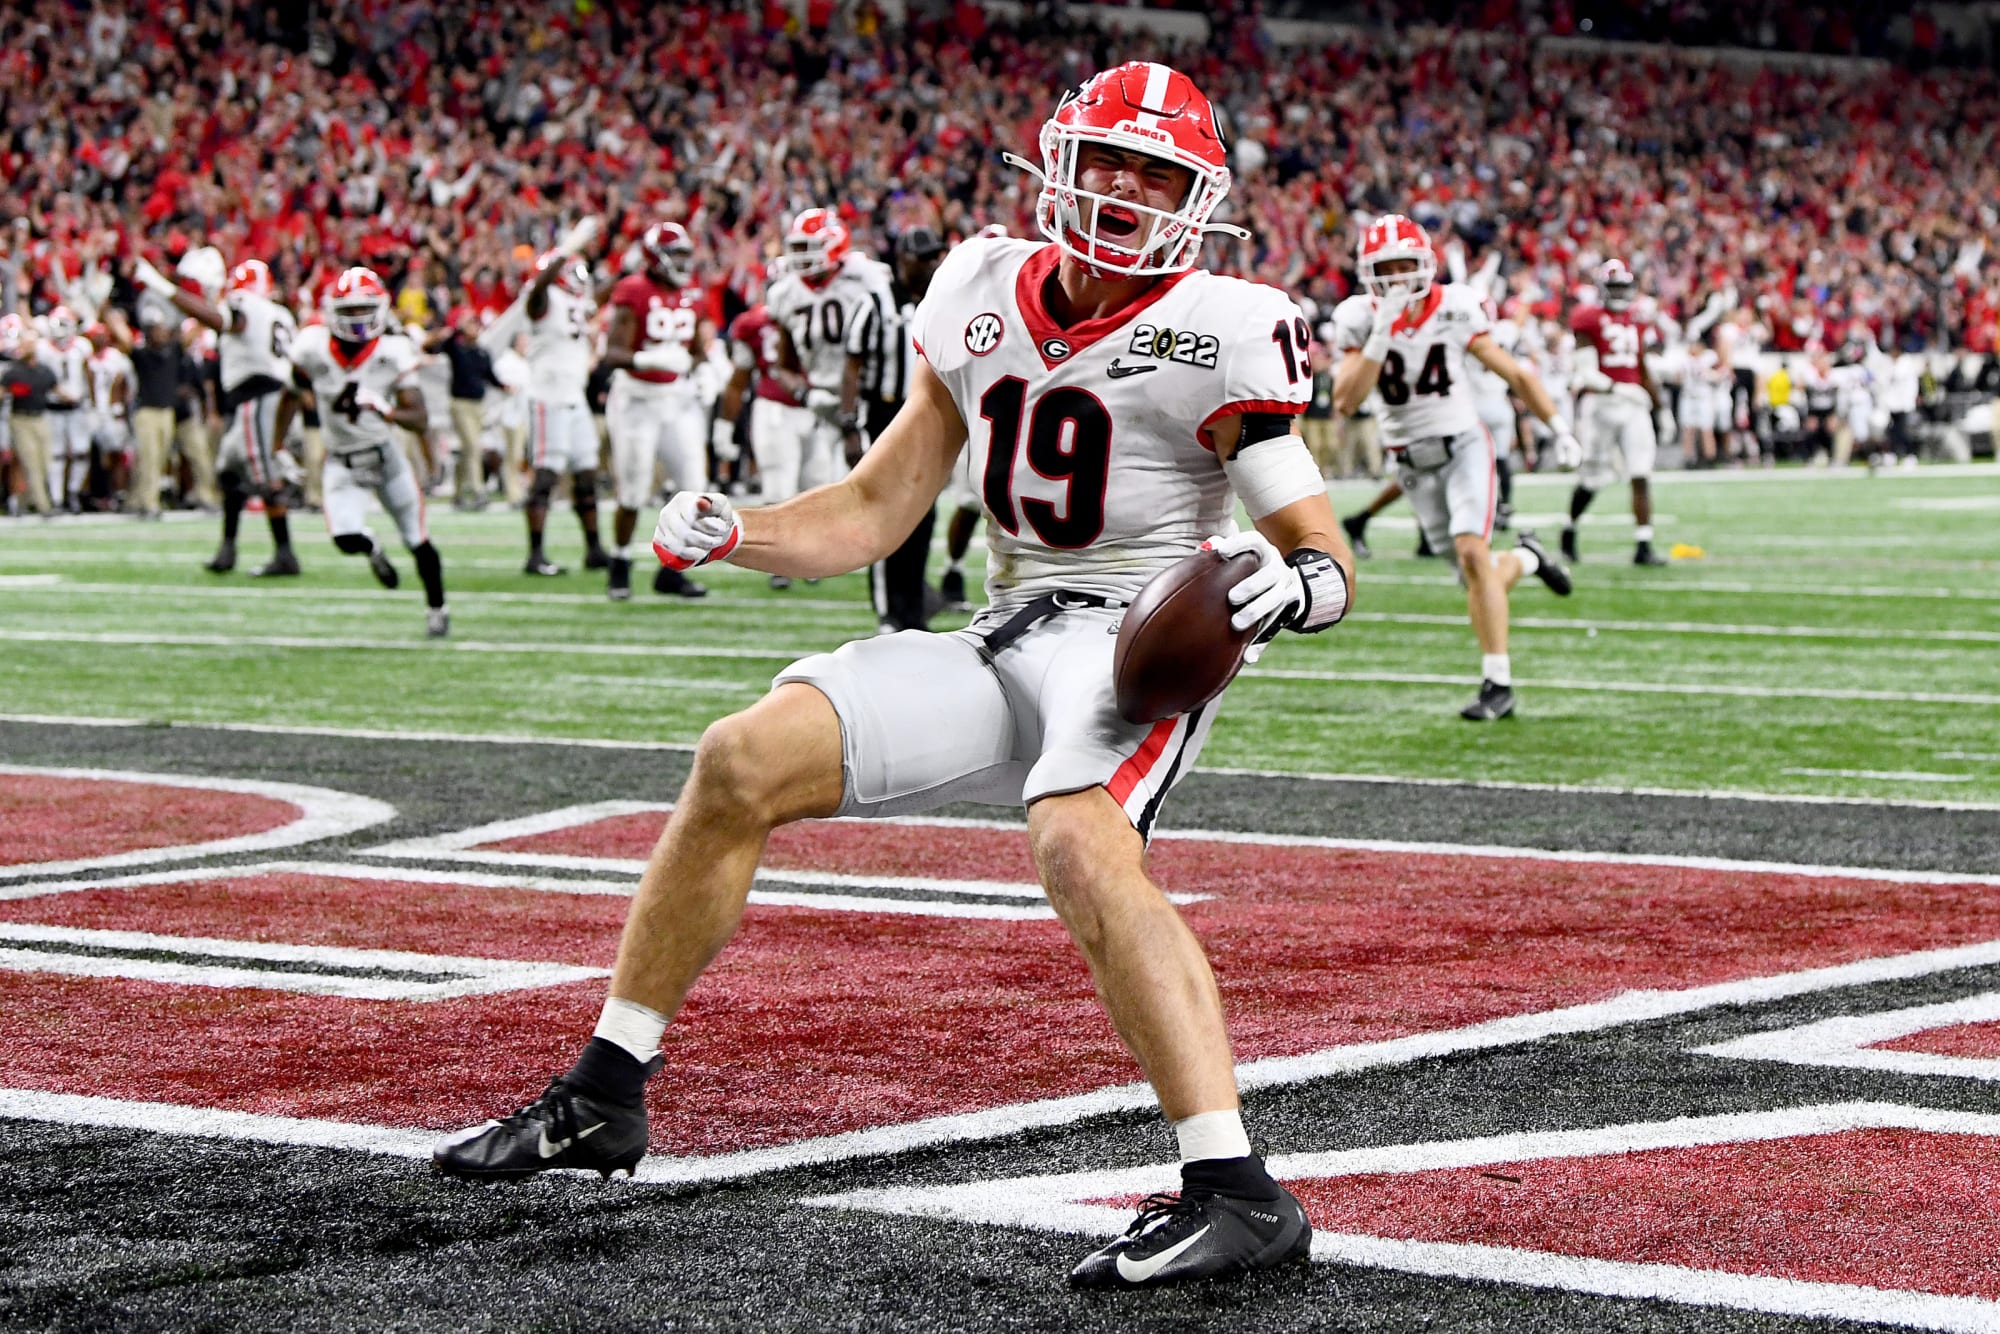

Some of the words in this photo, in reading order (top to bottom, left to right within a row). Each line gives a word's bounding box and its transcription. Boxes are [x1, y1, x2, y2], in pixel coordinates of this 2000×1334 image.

[1122, 123, 1167, 143] DAWGS
[794, 299, 844, 350] 70
[966, 314, 1001, 353] SEC
[1128, 323, 1220, 369] 2022
[1042, 338, 1070, 359] G
[1271, 315, 1313, 386] 19
[1377, 342, 1454, 406] 84
[332, 381, 362, 424] 4
[980, 374, 1113, 550] 19
[1249, 1208, 1280, 1224] VAPOR
